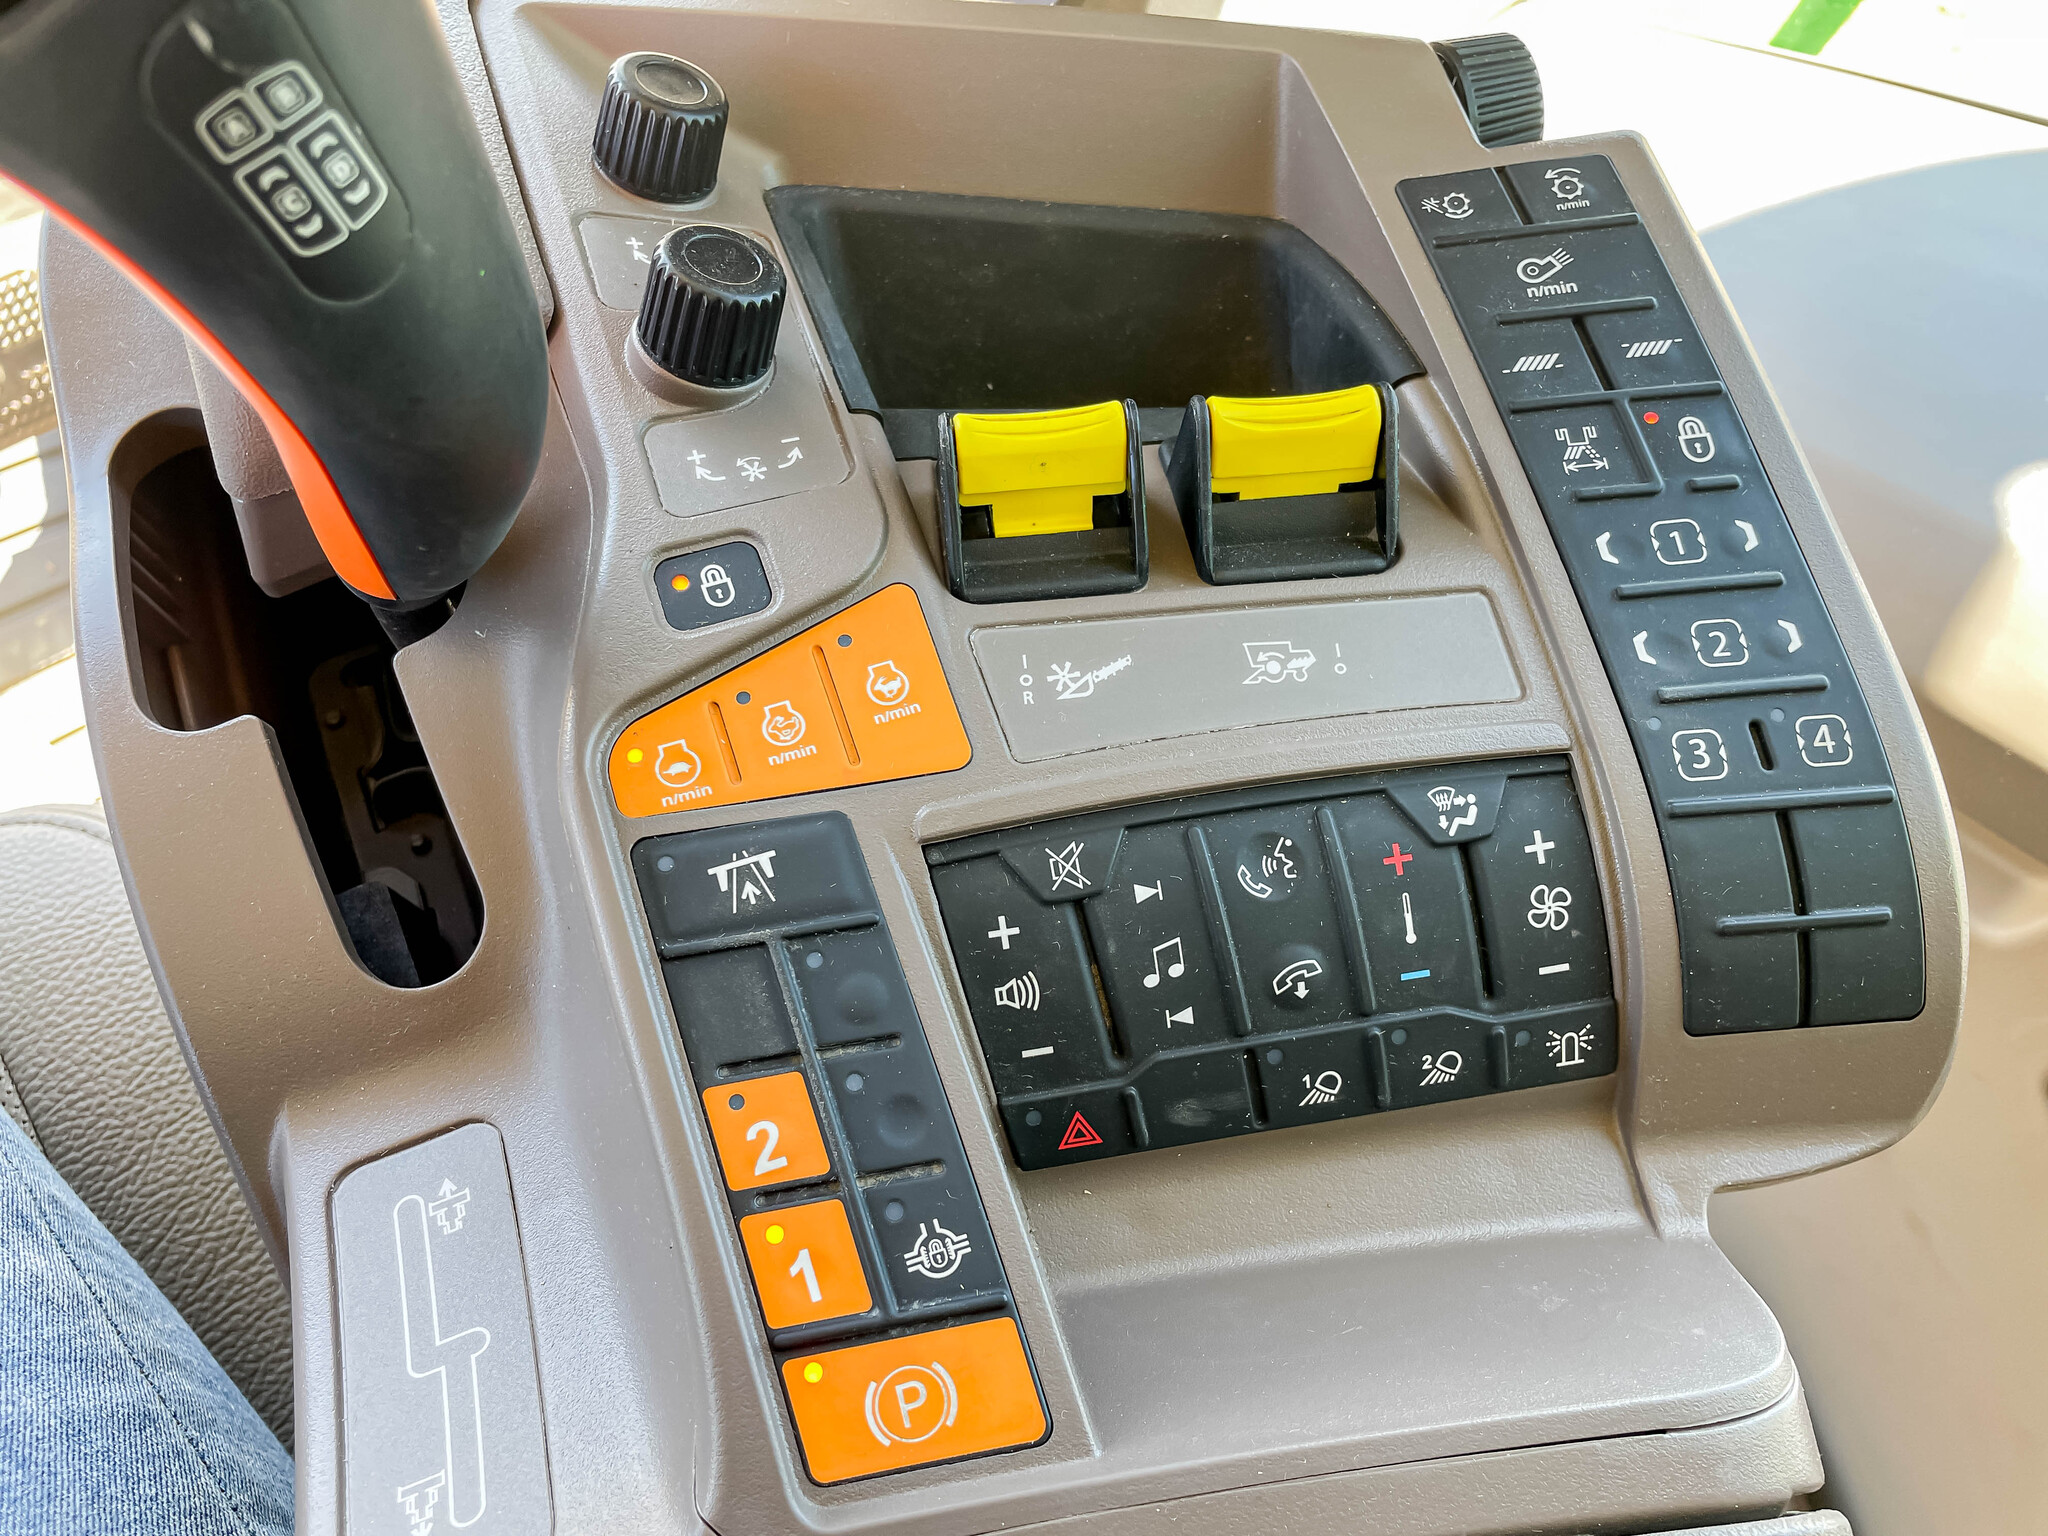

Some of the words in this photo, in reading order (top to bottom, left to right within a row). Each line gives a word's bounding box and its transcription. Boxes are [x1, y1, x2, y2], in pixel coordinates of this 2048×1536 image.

[1556, 198, 1590, 211] n/min
[1527, 280, 1579, 298] n/min
[1669, 530, 1685, 555] 1
[1709, 631, 1732, 657] 2
[1024, 692, 1034, 705] R
[873, 701, 922, 725] n/min
[1813, 724, 1836, 754] 4
[768, 743, 817, 766] n/min
[1688, 738, 1711, 769] 3
[661, 785, 712, 807] n/min
[1421, 1055, 1433, 1070] 2
[1302, 1074, 1311, 1089] 1
[745, 1120, 788, 1177] 2
[789, 1248, 822, 1304] 1
[895, 1380, 927, 1429] P
